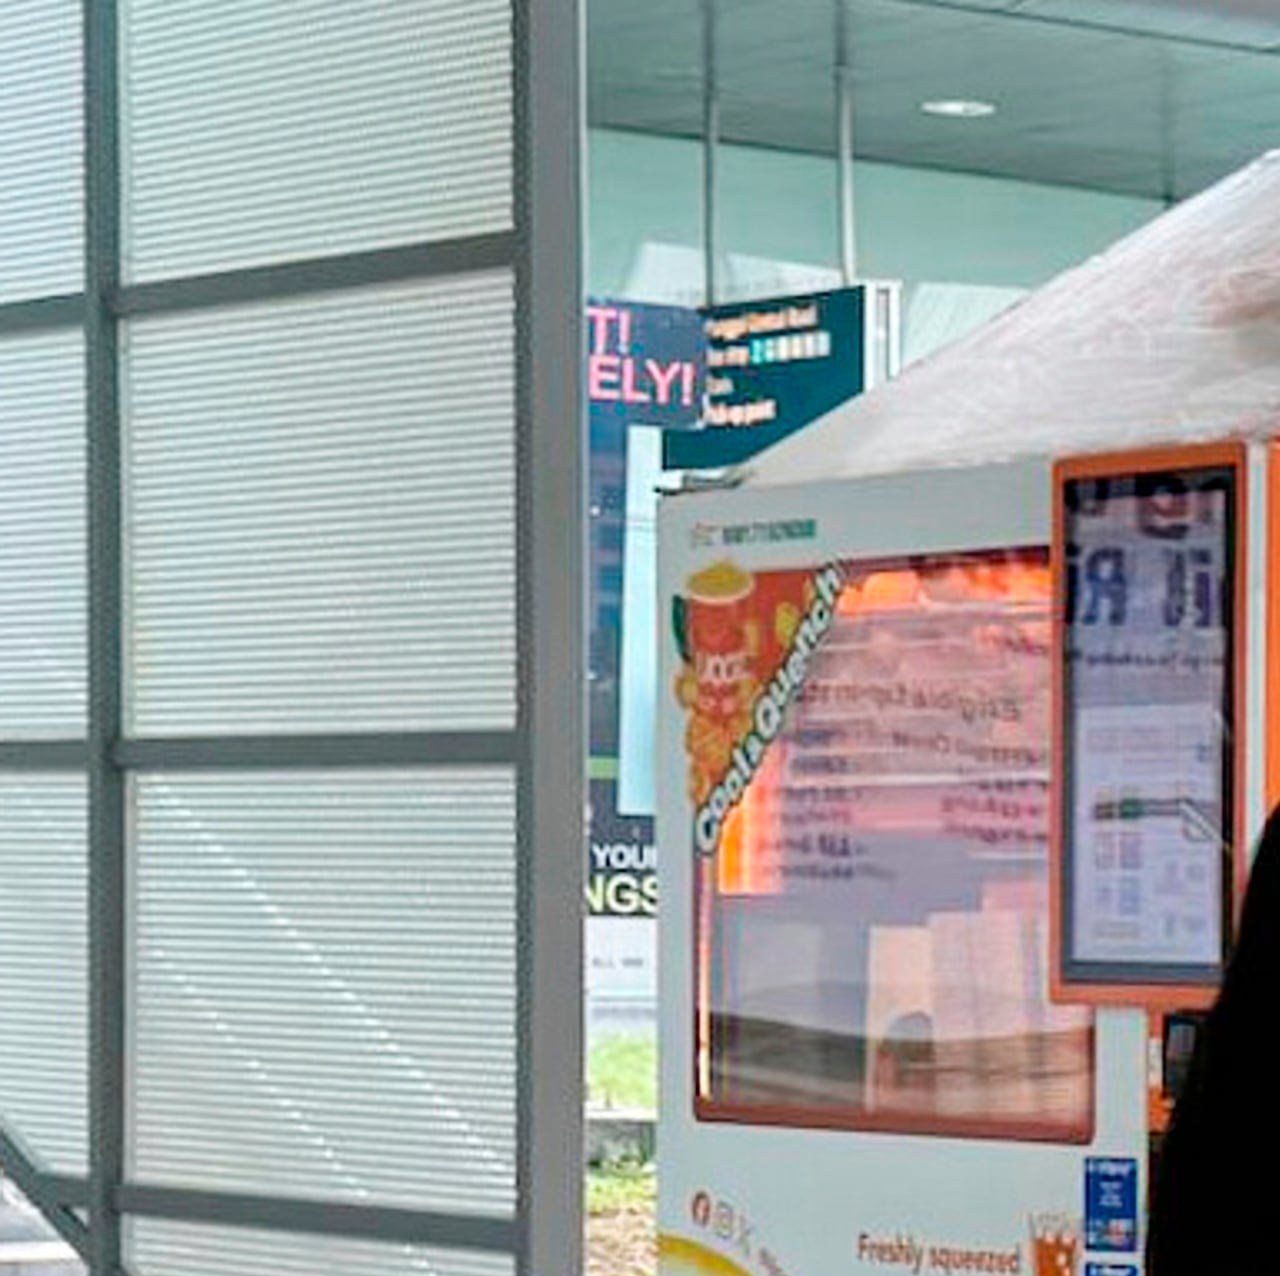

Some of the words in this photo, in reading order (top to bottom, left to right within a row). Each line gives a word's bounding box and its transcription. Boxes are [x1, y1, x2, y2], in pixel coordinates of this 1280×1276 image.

[592, 843, 657, 870] YOU
[857, 1231, 922, 1275] Freshly
[929, 1243, 1022, 1276] squeezed
